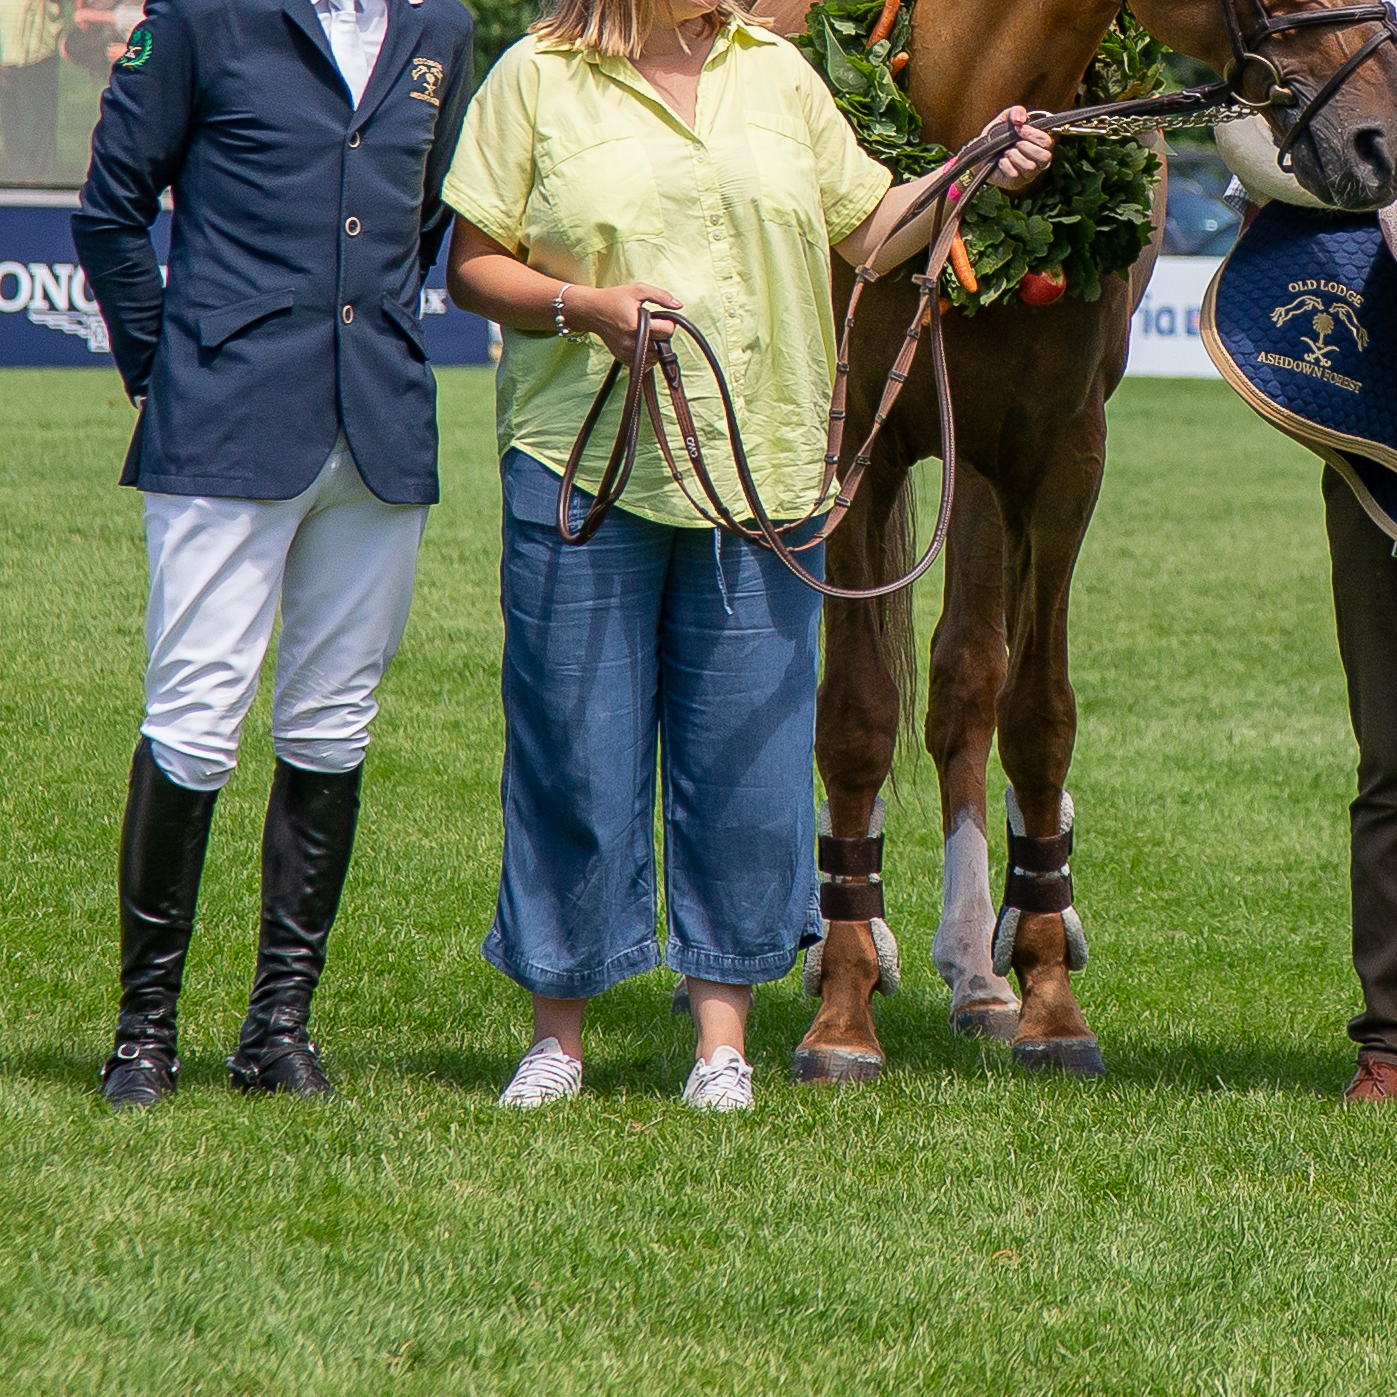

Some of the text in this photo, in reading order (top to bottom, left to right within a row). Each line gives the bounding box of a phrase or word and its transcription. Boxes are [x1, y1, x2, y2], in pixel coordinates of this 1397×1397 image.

[1288, 279, 1364, 308] OLD LODGE
[1257, 351, 1362, 394] ASHDOWN FOREST
